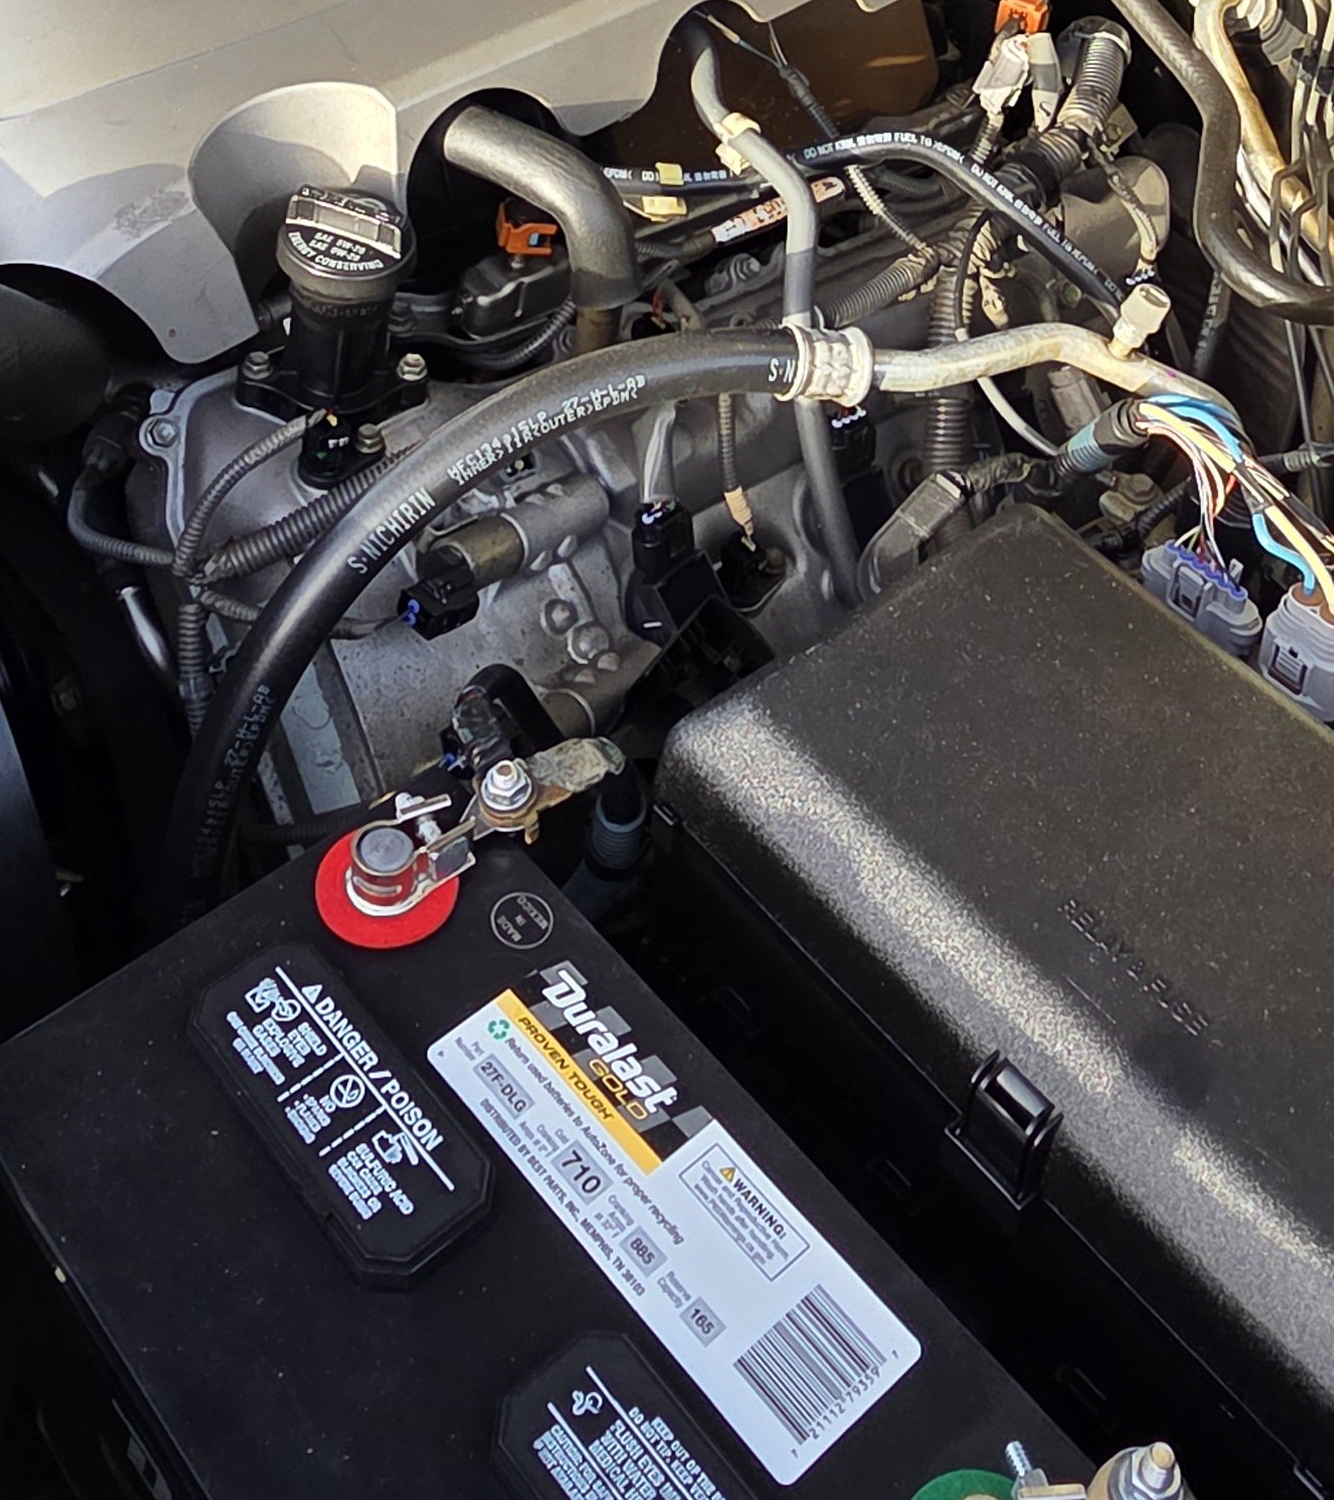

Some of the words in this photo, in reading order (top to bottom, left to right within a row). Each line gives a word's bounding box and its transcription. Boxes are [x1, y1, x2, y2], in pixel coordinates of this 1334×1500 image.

[313, 994, 381, 1074] DANGER
[378, 1076, 444, 1153] POISON
[516, 1014, 571, 1072] PROVEN
[565, 1070, 616, 1123] TOUGH
[535, 968, 683, 1117] Duralast
[478, 1059, 528, 1113] 27F-DLG
[585, 1056, 651, 1123] GOLD
[503, 1036, 531, 1065] Return
[525, 1061, 548, 1084] used
[541, 1080, 577, 1118] batteries
[571, 1114, 585, 1128] to
[579, 1124, 618, 1166] AutoZone
[612, 1162, 630, 1180] for
[622, 1175, 653, 1208] proper
[645, 1202, 686, 1246] recycling
[557, 1148, 604, 1197] 710
[478, 1097, 523, 1147] DISTRIBUTED
[516, 1142, 532, 1158] BY
[525, 1154, 548, 1177] BEST
[541, 1174, 570, 1205] PARTS,
[577, 1217, 617, 1261] MEMPHIS,
[610, 1256, 626, 1272] TN
[627, 1235, 657, 1266] 885
[686, 1305, 716, 1336] 165
[807, 1401, 846, 1441] 21112
[842, 1365, 883, 1405] 79359
[584, 1438, 635, 1493] MEDICAL
[596, 1429, 630, 1464] WITH
[606, 1418, 647, 1460] FLUSH
[634, 1453, 668, 1488] EYES
[667, 1439, 691, 1463] OUT
